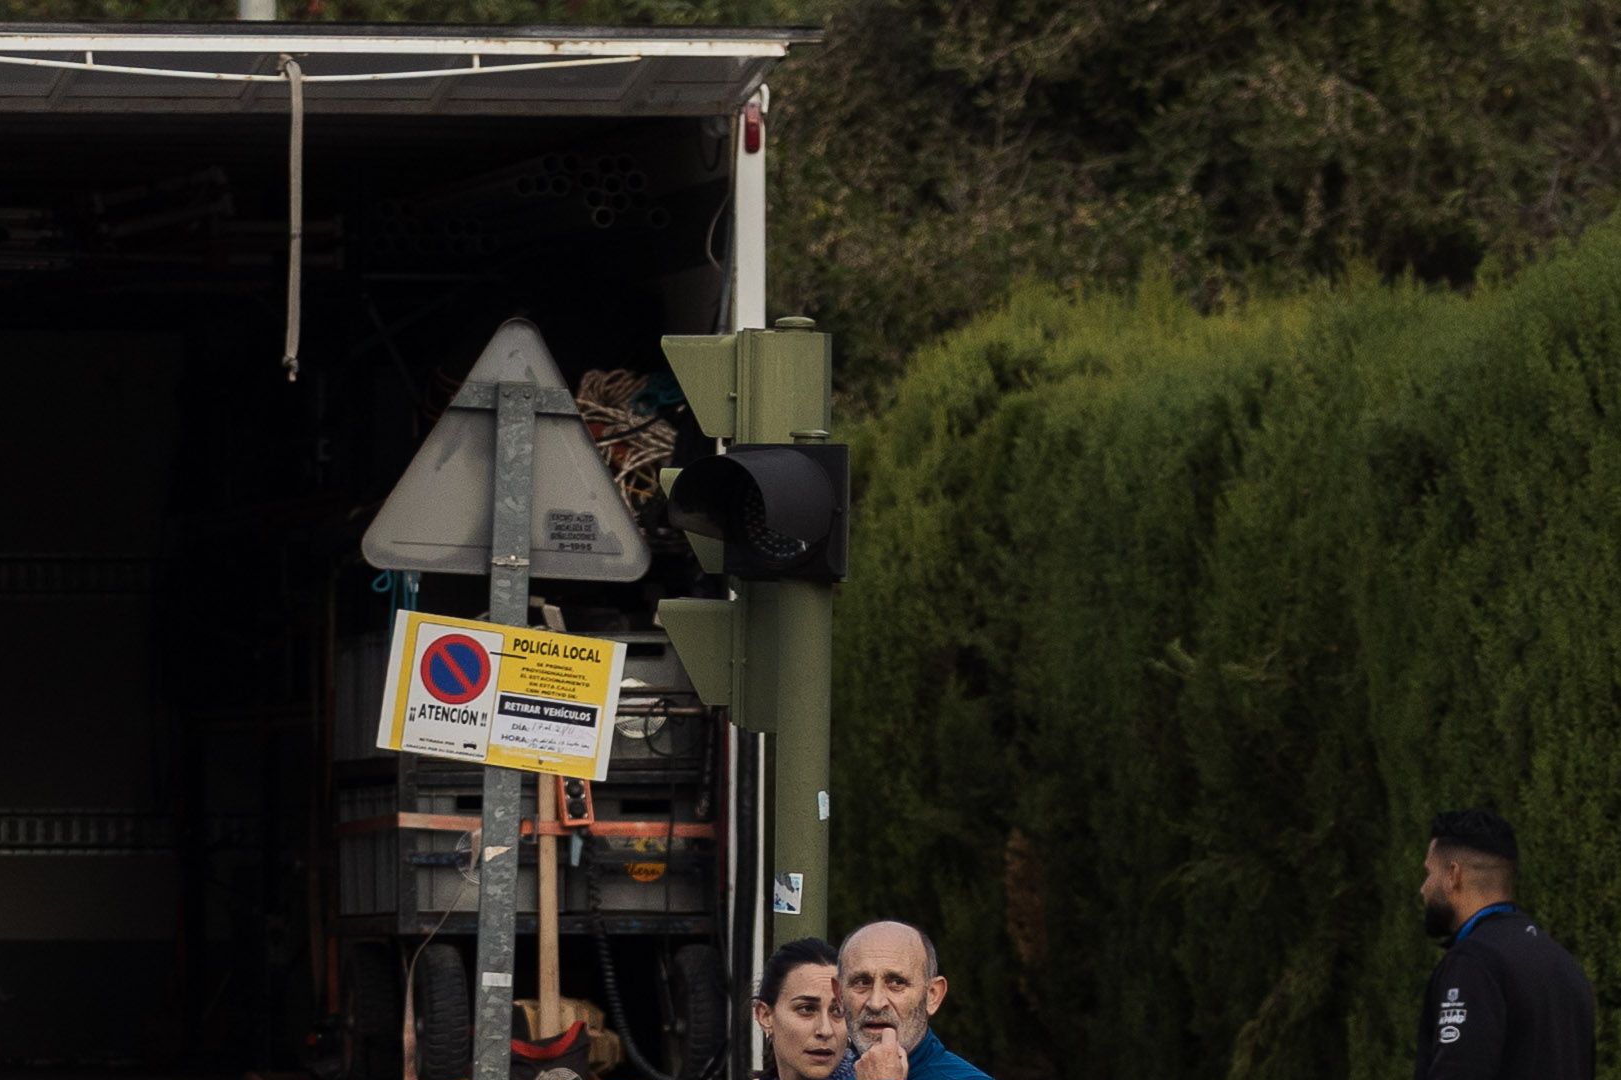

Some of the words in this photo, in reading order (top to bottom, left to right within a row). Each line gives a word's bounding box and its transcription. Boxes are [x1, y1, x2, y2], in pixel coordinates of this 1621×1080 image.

[513, 638, 560, 657] POLICÍA
[562, 645, 601, 663] LOCAL
[418, 703, 479, 726] ATENCIÓN
[504, 701, 541, 715] RETIRAR
[543, 706, 592, 722] VEHÍCULOS
